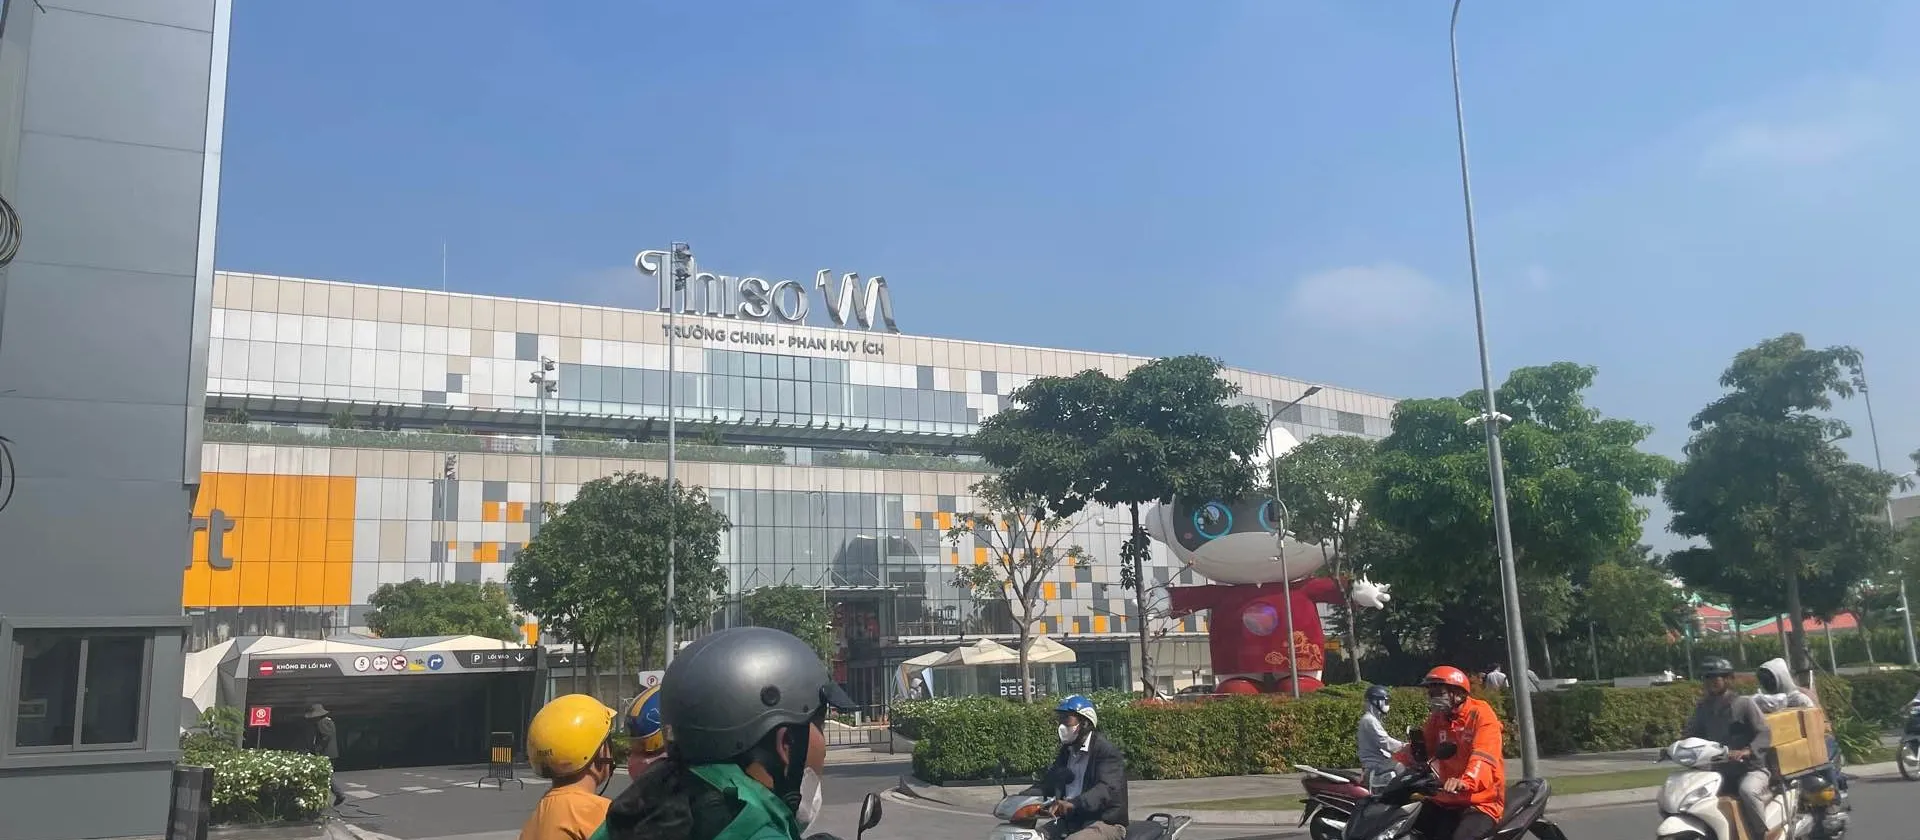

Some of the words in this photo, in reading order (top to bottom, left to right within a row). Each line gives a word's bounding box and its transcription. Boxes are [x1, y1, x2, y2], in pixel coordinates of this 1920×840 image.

[661, 323, 727, 343] TRƯỜNG
[729, 331, 775, 347] CHINH
[788, 335, 827, 350] PHAN
[830, 341, 860, 354] HUY
[862, 340, 885, 356] ÍCH
[276, 662, 299, 670] KHÔNG
